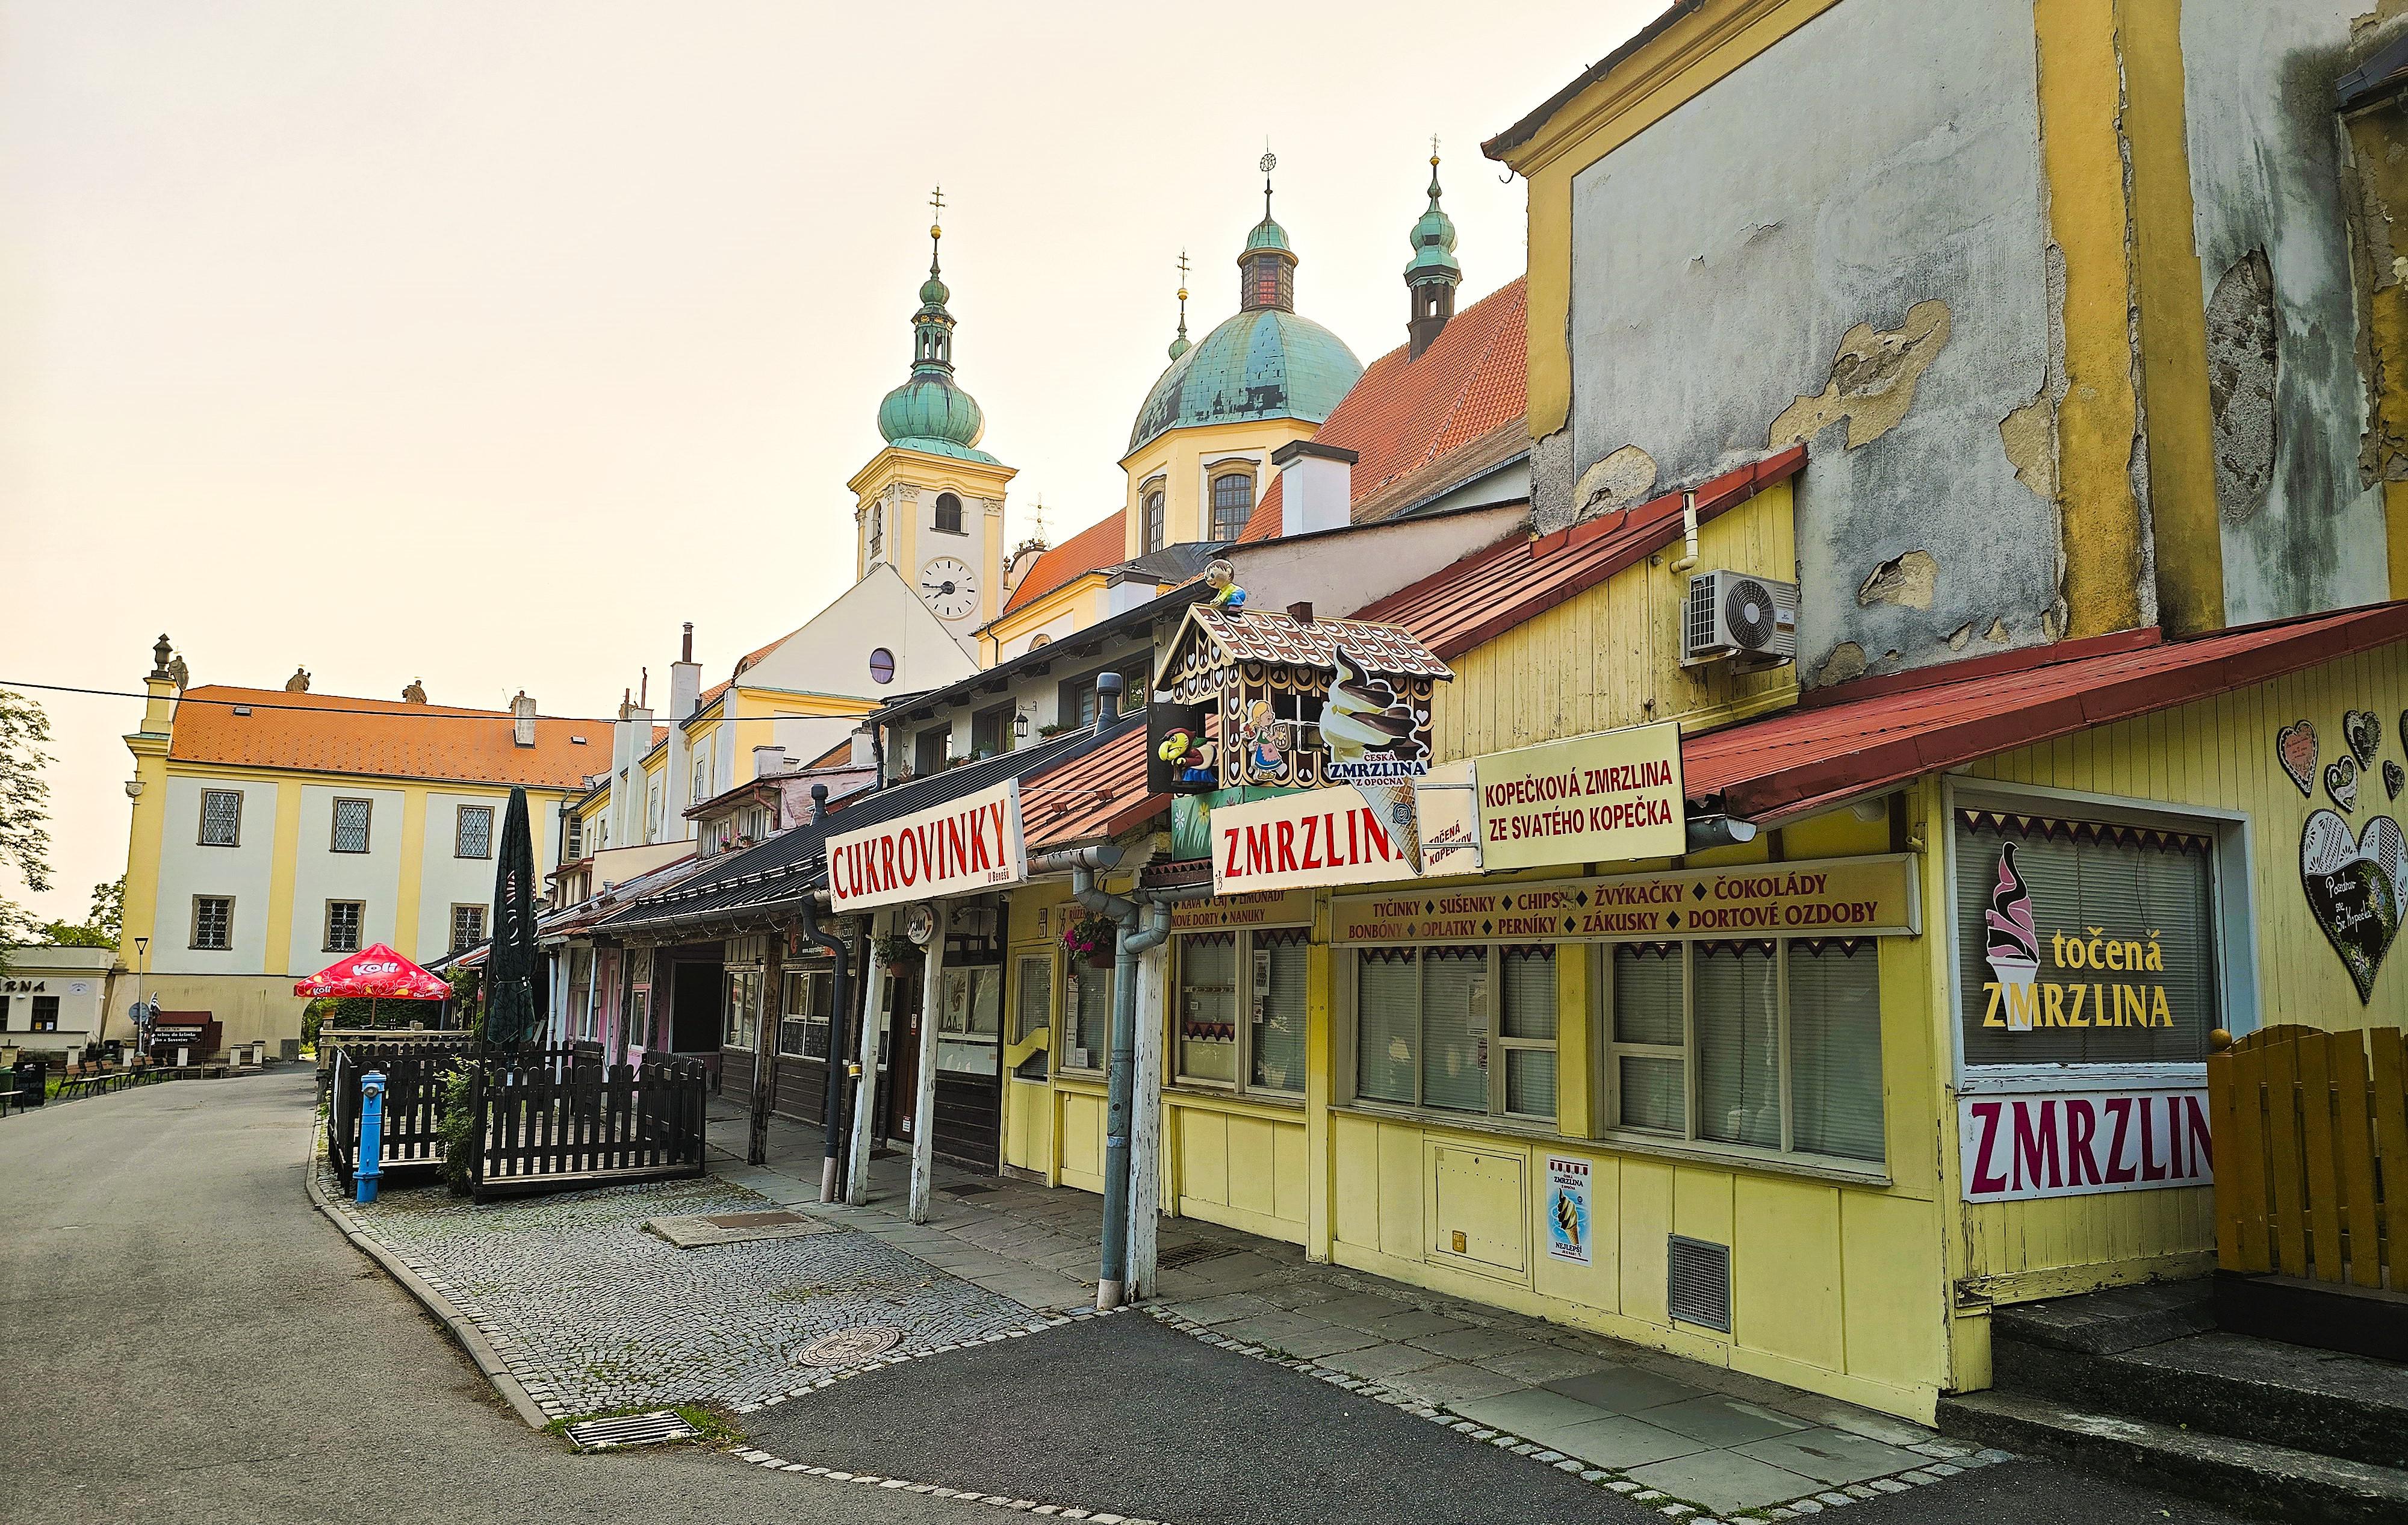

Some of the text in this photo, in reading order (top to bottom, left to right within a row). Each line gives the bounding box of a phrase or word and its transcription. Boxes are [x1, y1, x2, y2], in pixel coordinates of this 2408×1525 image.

[1329, 761, 1426, 778] ZMRZLINA
[1364, 752, 1395, 762] ČESKÁ
[1485, 760, 1673, 807] KOPEČKOVÁ ZMRZLINA
[1489, 795, 1673, 842] ZE SVATÉHO KOPEČKA
[833, 799, 1007, 899] CUKROVINKY
[1373, 898, 1421, 918] TYČINKY
[1439, 893, 1496, 914] SUŠENKY
[1594, 880, 1684, 907] ŽVÝKAČKY
[1714, 871, 1828, 900] ČOKOLÁDY
[1171, 908, 1265, 928] KOVÉ DORTY NANUKY
[1348, 901, 1878, 939] BONBÓNY OPLATKY PERNÍKY ZÁKUSKY DORTOVÉ OZDOBY
[2052, 926, 2164, 971] točená
[1982, 982, 2174, 1028] ZMRZLINA
[1970, 1095, 2215, 1194] ZMRZLIN
[1554, 1176, 1584, 1187] ZMRZLINA
[1555, 1241, 1582, 1253] NEJLEPŠÍ
